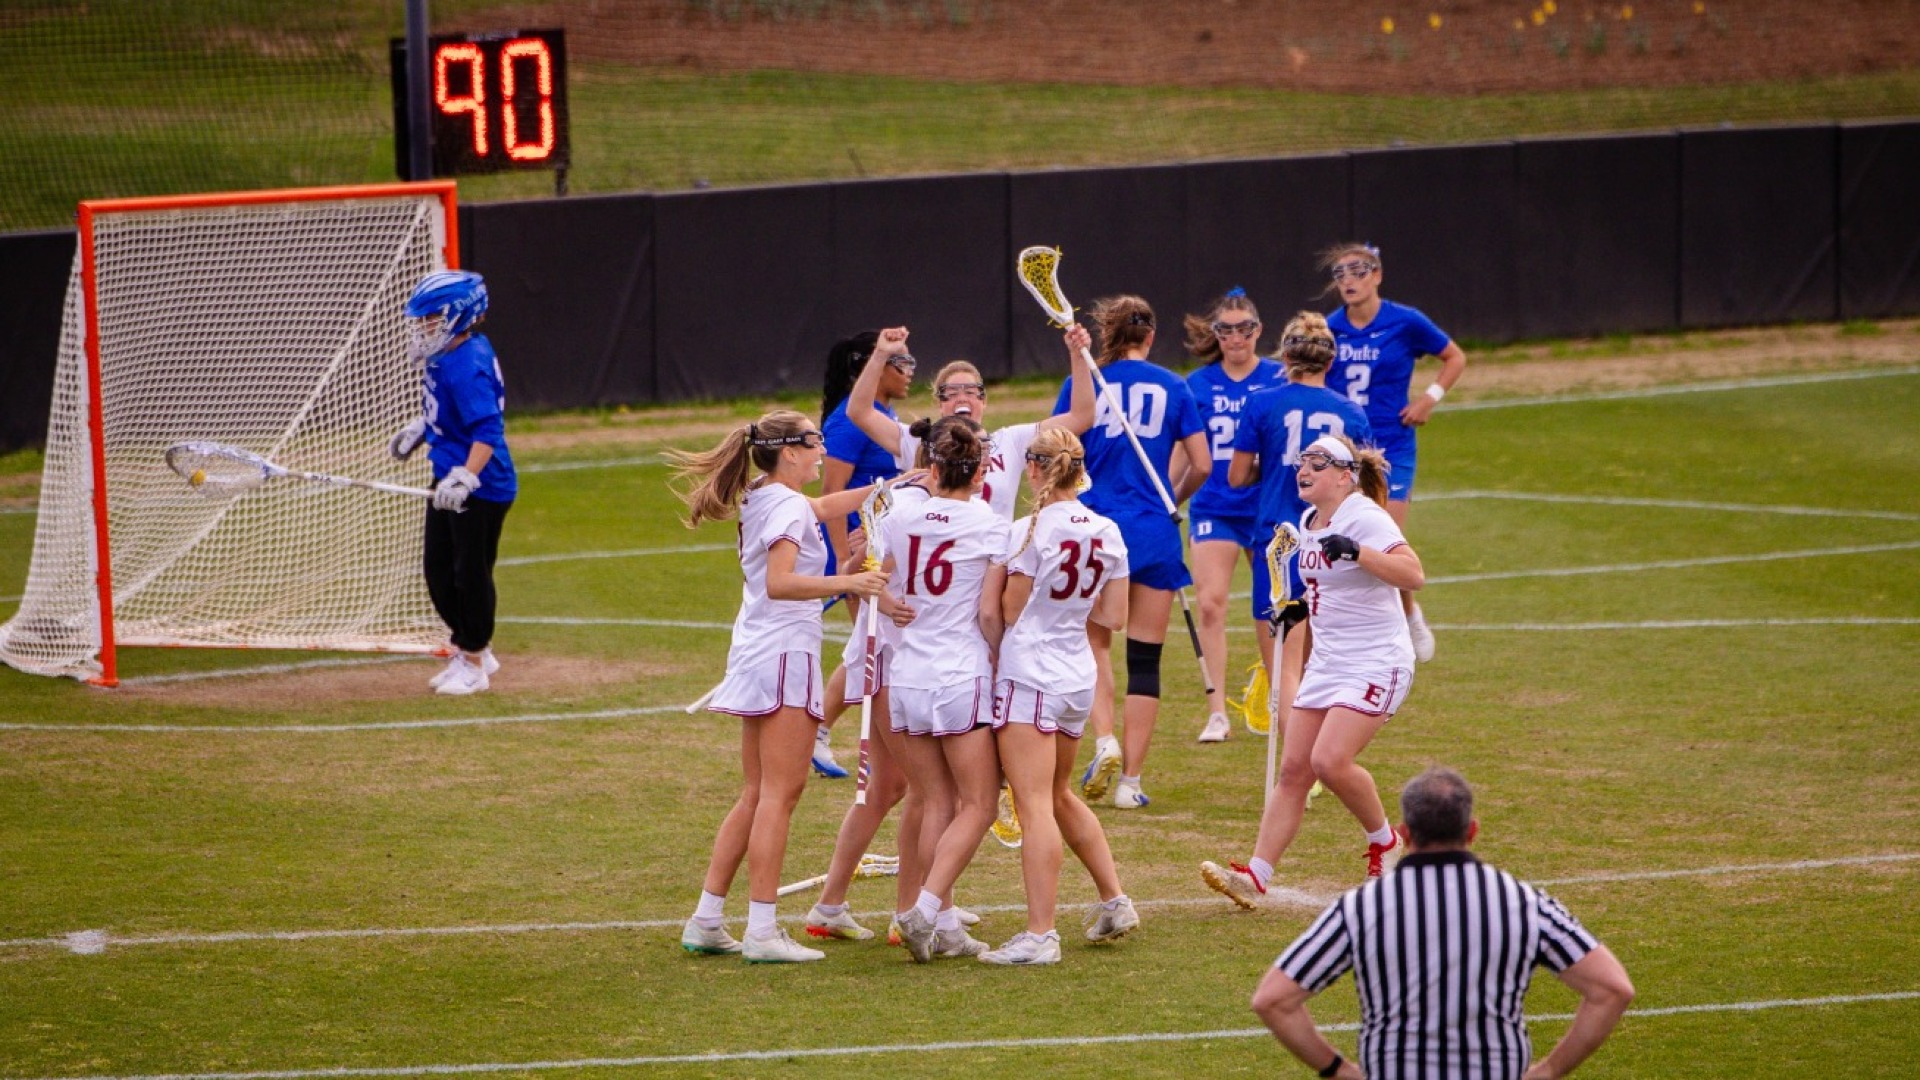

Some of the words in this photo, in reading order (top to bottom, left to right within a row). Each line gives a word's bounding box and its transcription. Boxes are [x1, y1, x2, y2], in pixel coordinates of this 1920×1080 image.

[436, 38, 553, 160] 90
[1339, 343, 1380, 361] Duke
[1346, 363, 1370, 406] 2
[1093, 381, 1167, 438] 40
[1208, 416, 1240, 460] 2
[905, 534, 956, 596] 16
[1051, 538, 1104, 600] 35
[1300, 548, 1333, 569] LON
[1362, 682, 1386, 707] E
